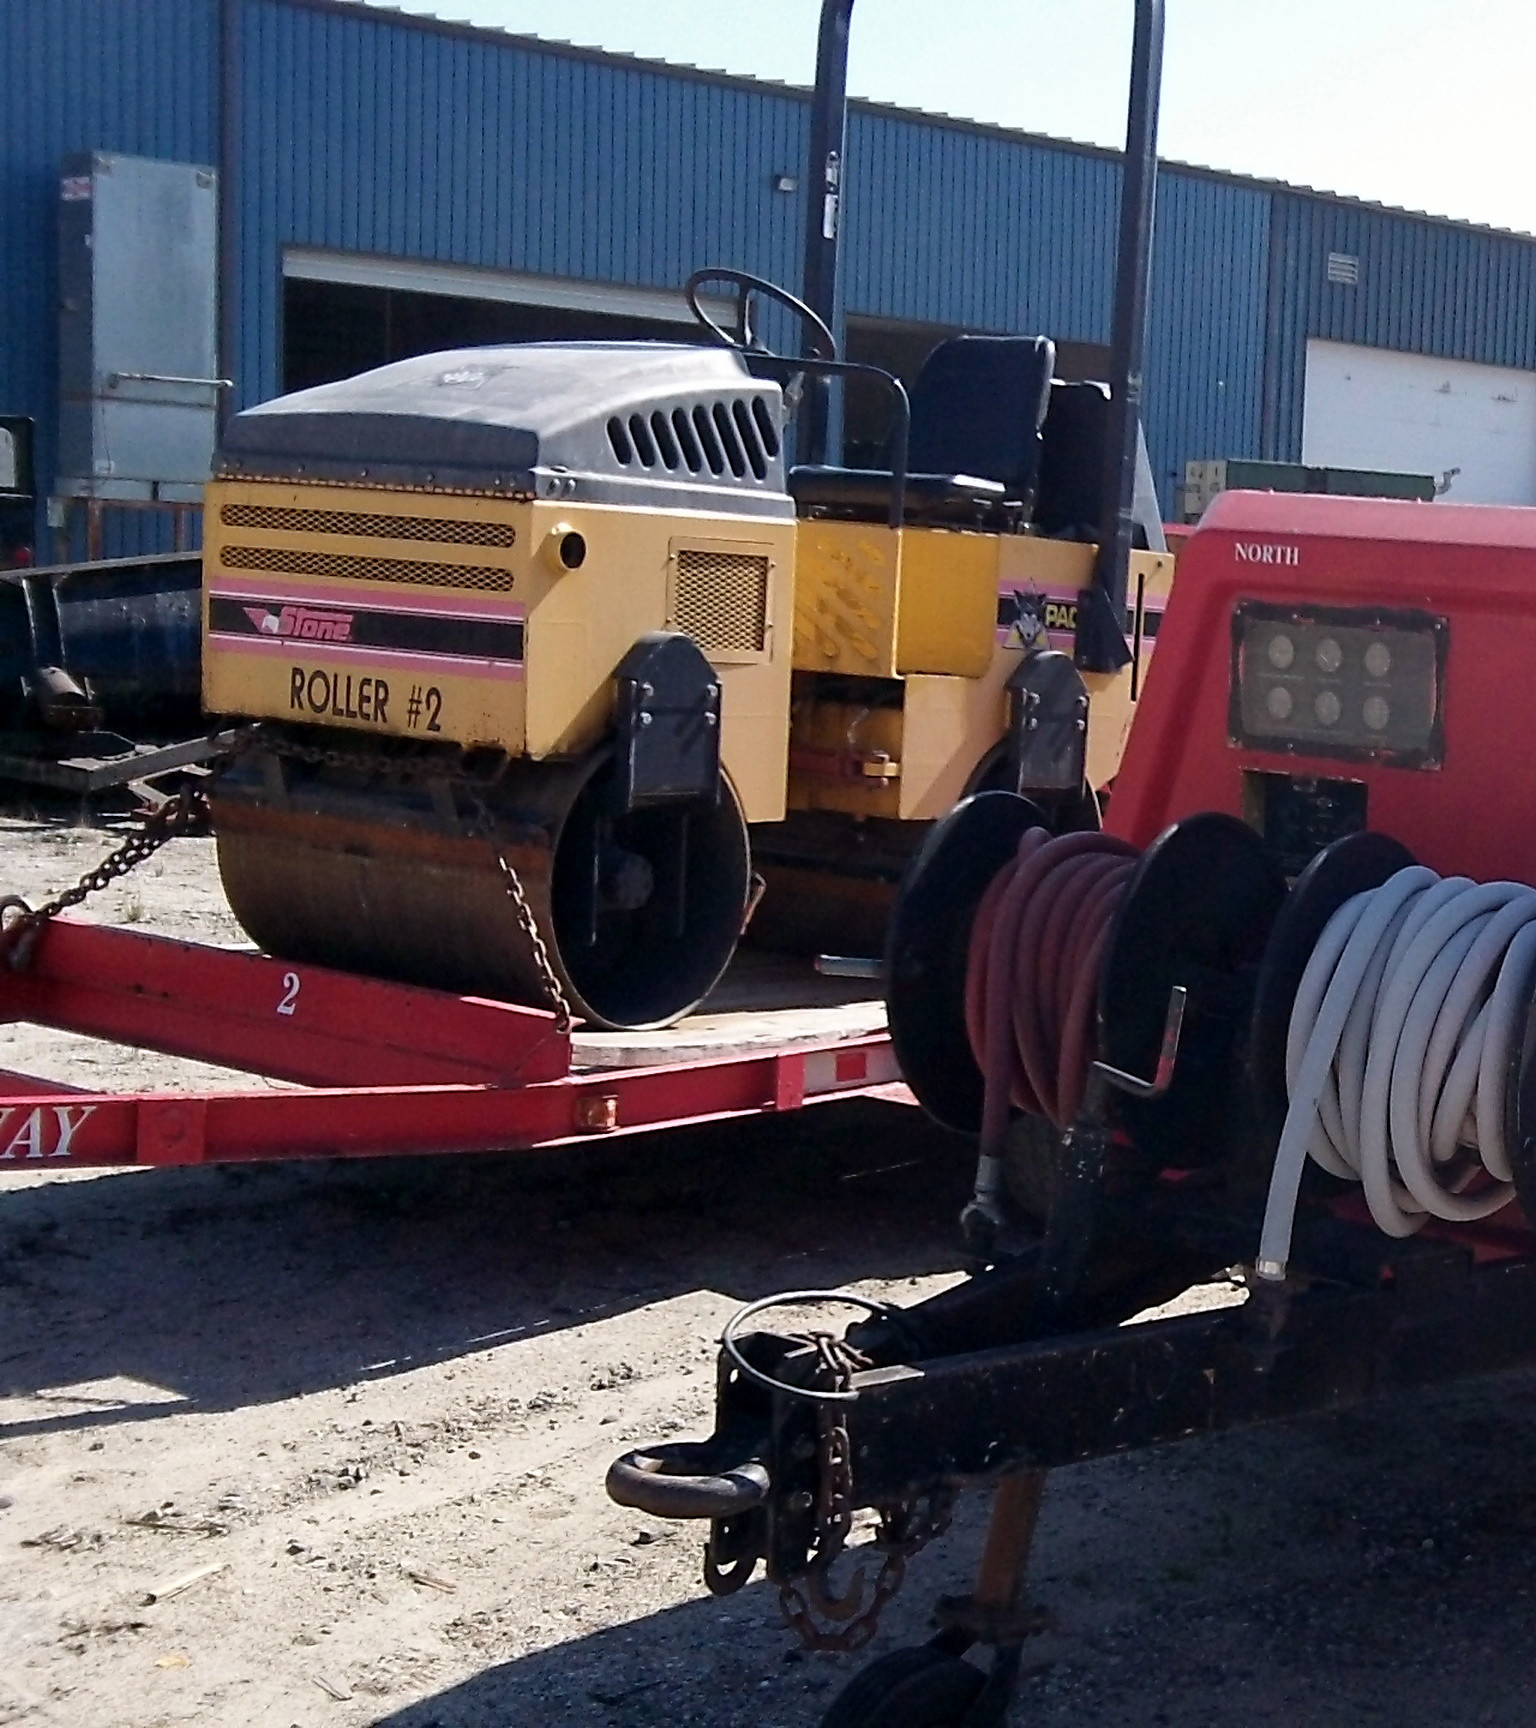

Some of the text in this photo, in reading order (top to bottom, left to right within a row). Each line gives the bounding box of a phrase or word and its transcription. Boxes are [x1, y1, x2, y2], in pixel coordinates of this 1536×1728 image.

[1234, 542, 1300, 567] NORTH
[289, 666, 443, 733] ROLLER #2
[277, 972, 301, 1016] 2
